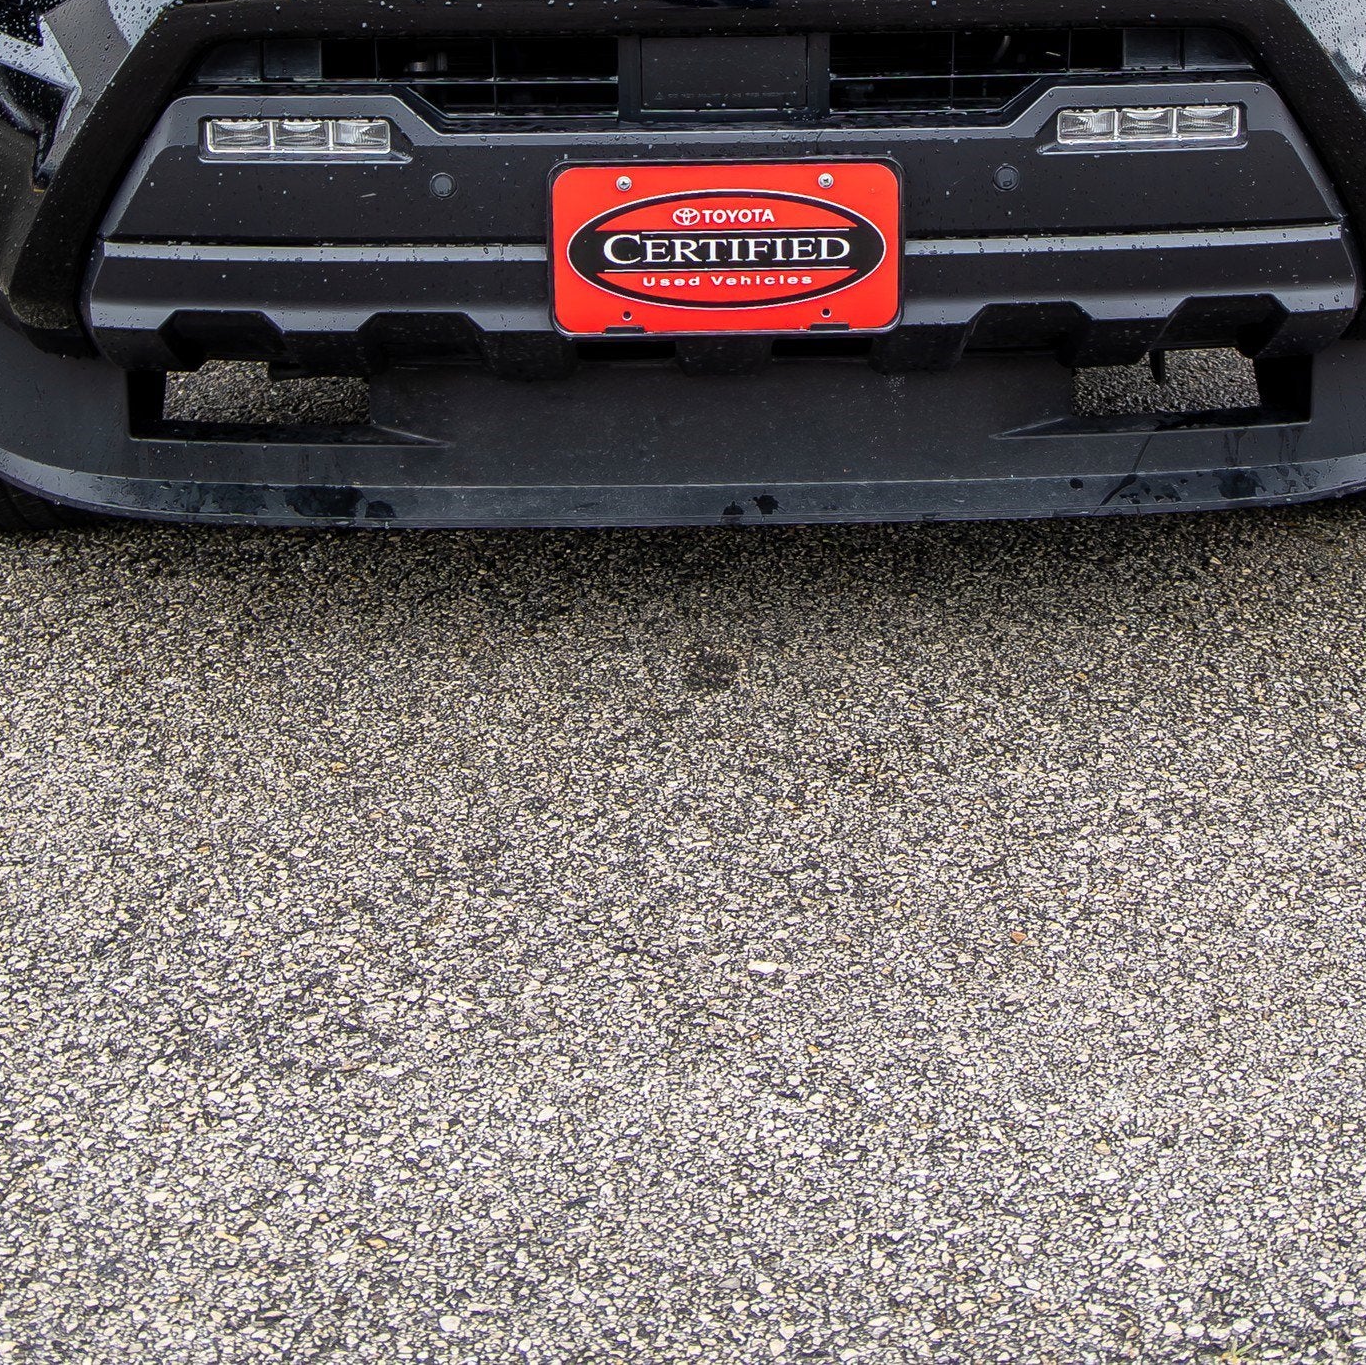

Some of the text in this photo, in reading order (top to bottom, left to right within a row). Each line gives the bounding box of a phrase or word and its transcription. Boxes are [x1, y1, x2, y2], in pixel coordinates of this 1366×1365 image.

[702, 208, 775, 223] TOYOTA
[643, 275, 812, 286] Used Vehicles
